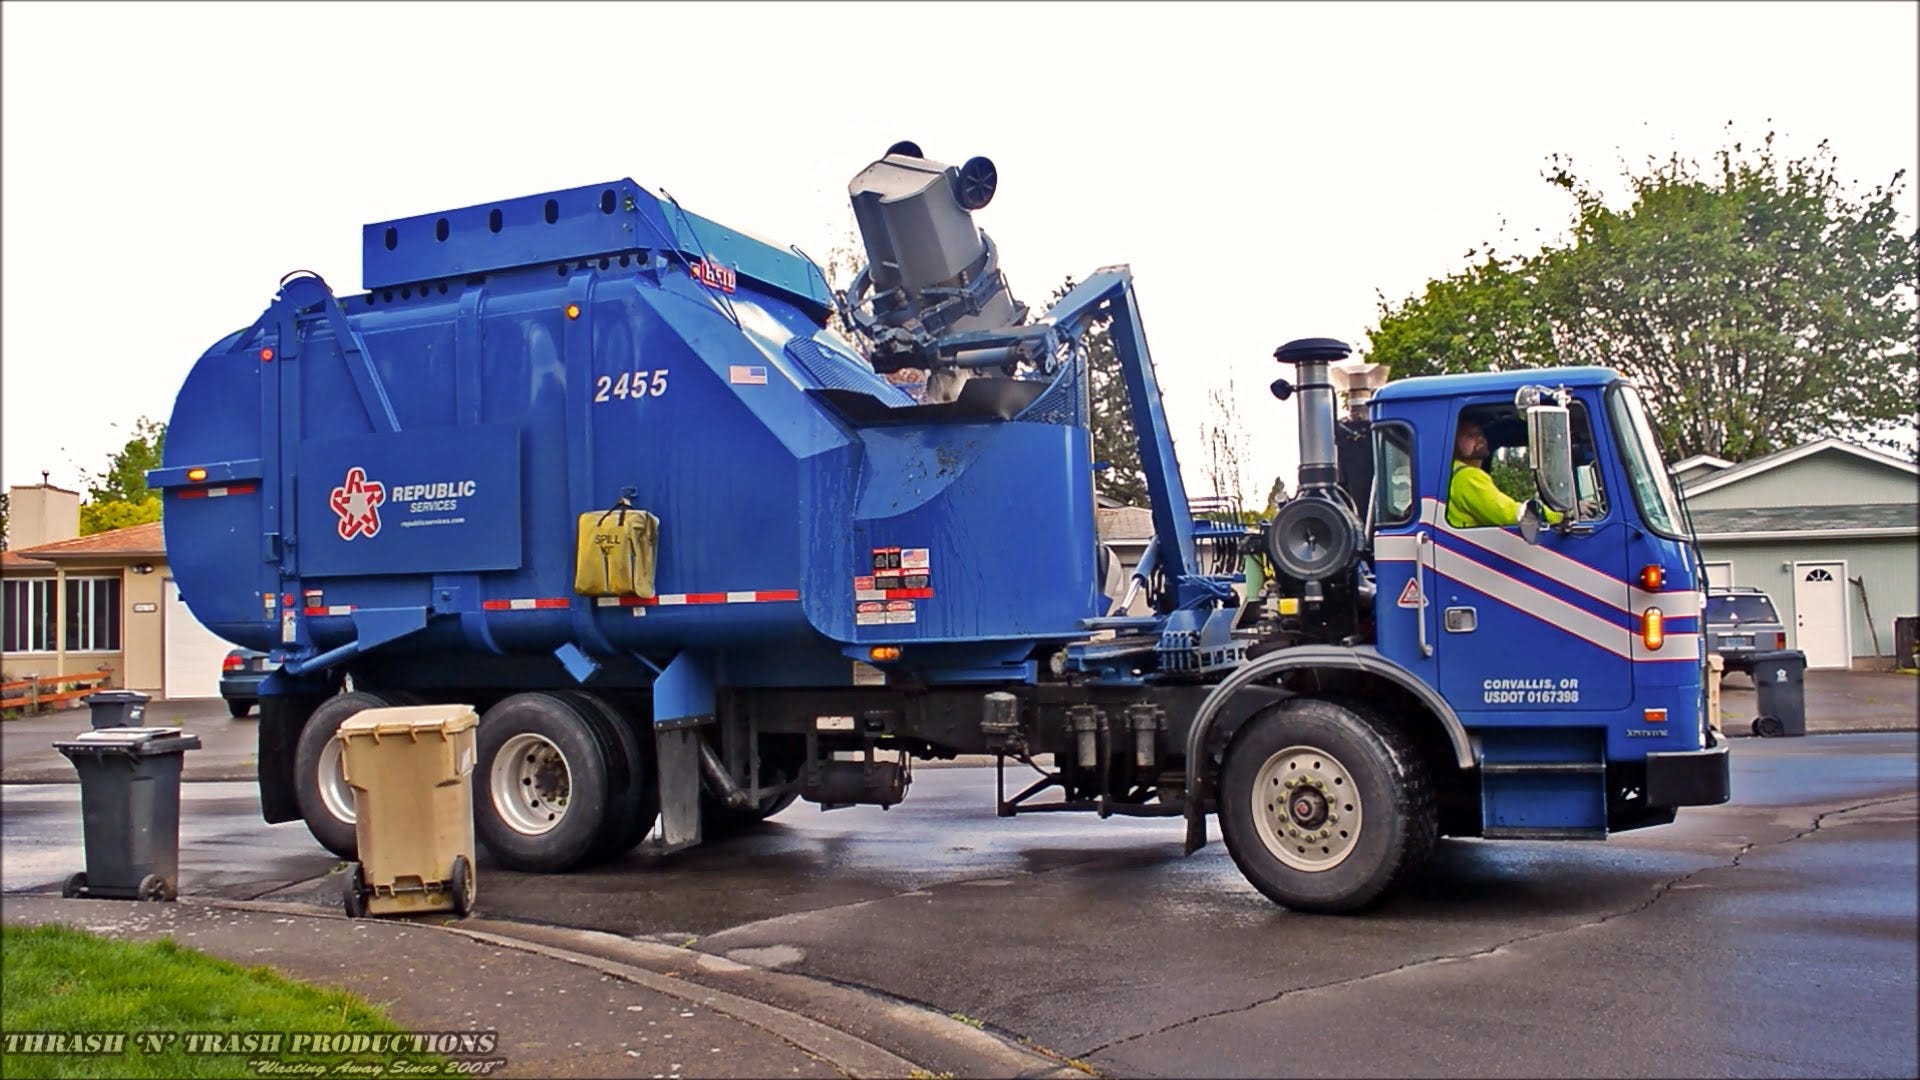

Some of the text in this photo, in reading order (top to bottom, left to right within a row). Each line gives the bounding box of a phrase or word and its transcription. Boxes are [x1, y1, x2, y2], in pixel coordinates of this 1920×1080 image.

[594, 369, 669, 402] 2455
[392, 480, 476, 502] REPUBLIC
[410, 499, 457, 513] SERVICES
[595, 534, 620, 544] SPILL
[1483, 678, 1579, 690] CORVALLIS, OR
[1484, 690, 1579, 704] USDOT 0167398
